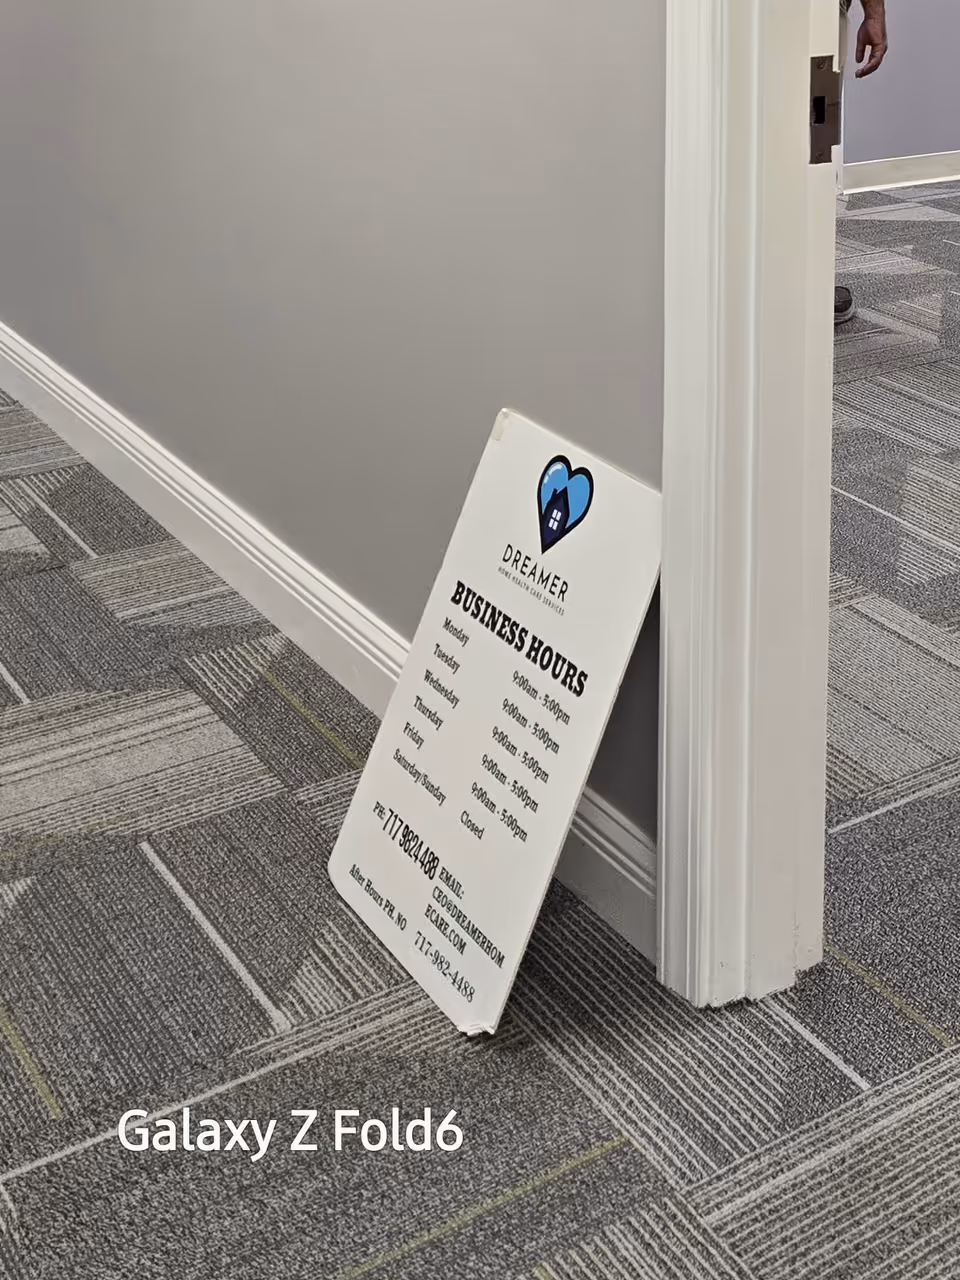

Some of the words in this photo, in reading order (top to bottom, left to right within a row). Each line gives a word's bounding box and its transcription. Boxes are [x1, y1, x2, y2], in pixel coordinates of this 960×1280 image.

[502, 544, 569, 602] DREAMER
[443, 617, 470, 647] Monday
[512, 670, 539, 700] 9:00am
[541, 694, 571, 725] 5:00pm
[450, 580, 529, 652] BUSINESS
[525, 634, 588, 697] HOURS
[423, 669, 460, 709] Wednesday
[492, 726, 518, 757] 9:00am
[521, 751, 549, 784] 5:00pm
[433, 643, 461, 674] Tuesday
[502, 698, 528, 728] 9:00am
[531, 722, 560, 754] 5:00pm
[393, 748, 447, 806] Saturday/Sunday
[460, 810, 485, 840] Closed
[402, 721, 425, 750] Friday
[471, 782, 497, 814] 9:00am
[499, 808, 528, 842] 5:00pm
[413, 695, 444, 730] Thursday
[481, 754, 507, 785] 9:00am
[510, 780, 539, 813] 5:00pm
[349, 864, 365, 886] After
[364, 878, 384, 907] Hours
[394, 912, 407, 931] NO
[414, 930, 476, 1003] 717-982-4488
[424, 904, 467, 956] ECARE.COM
[432, 886, 505, 969] CEO@DREAMERHOM
[438, 867, 465, 899] EMAIL:
